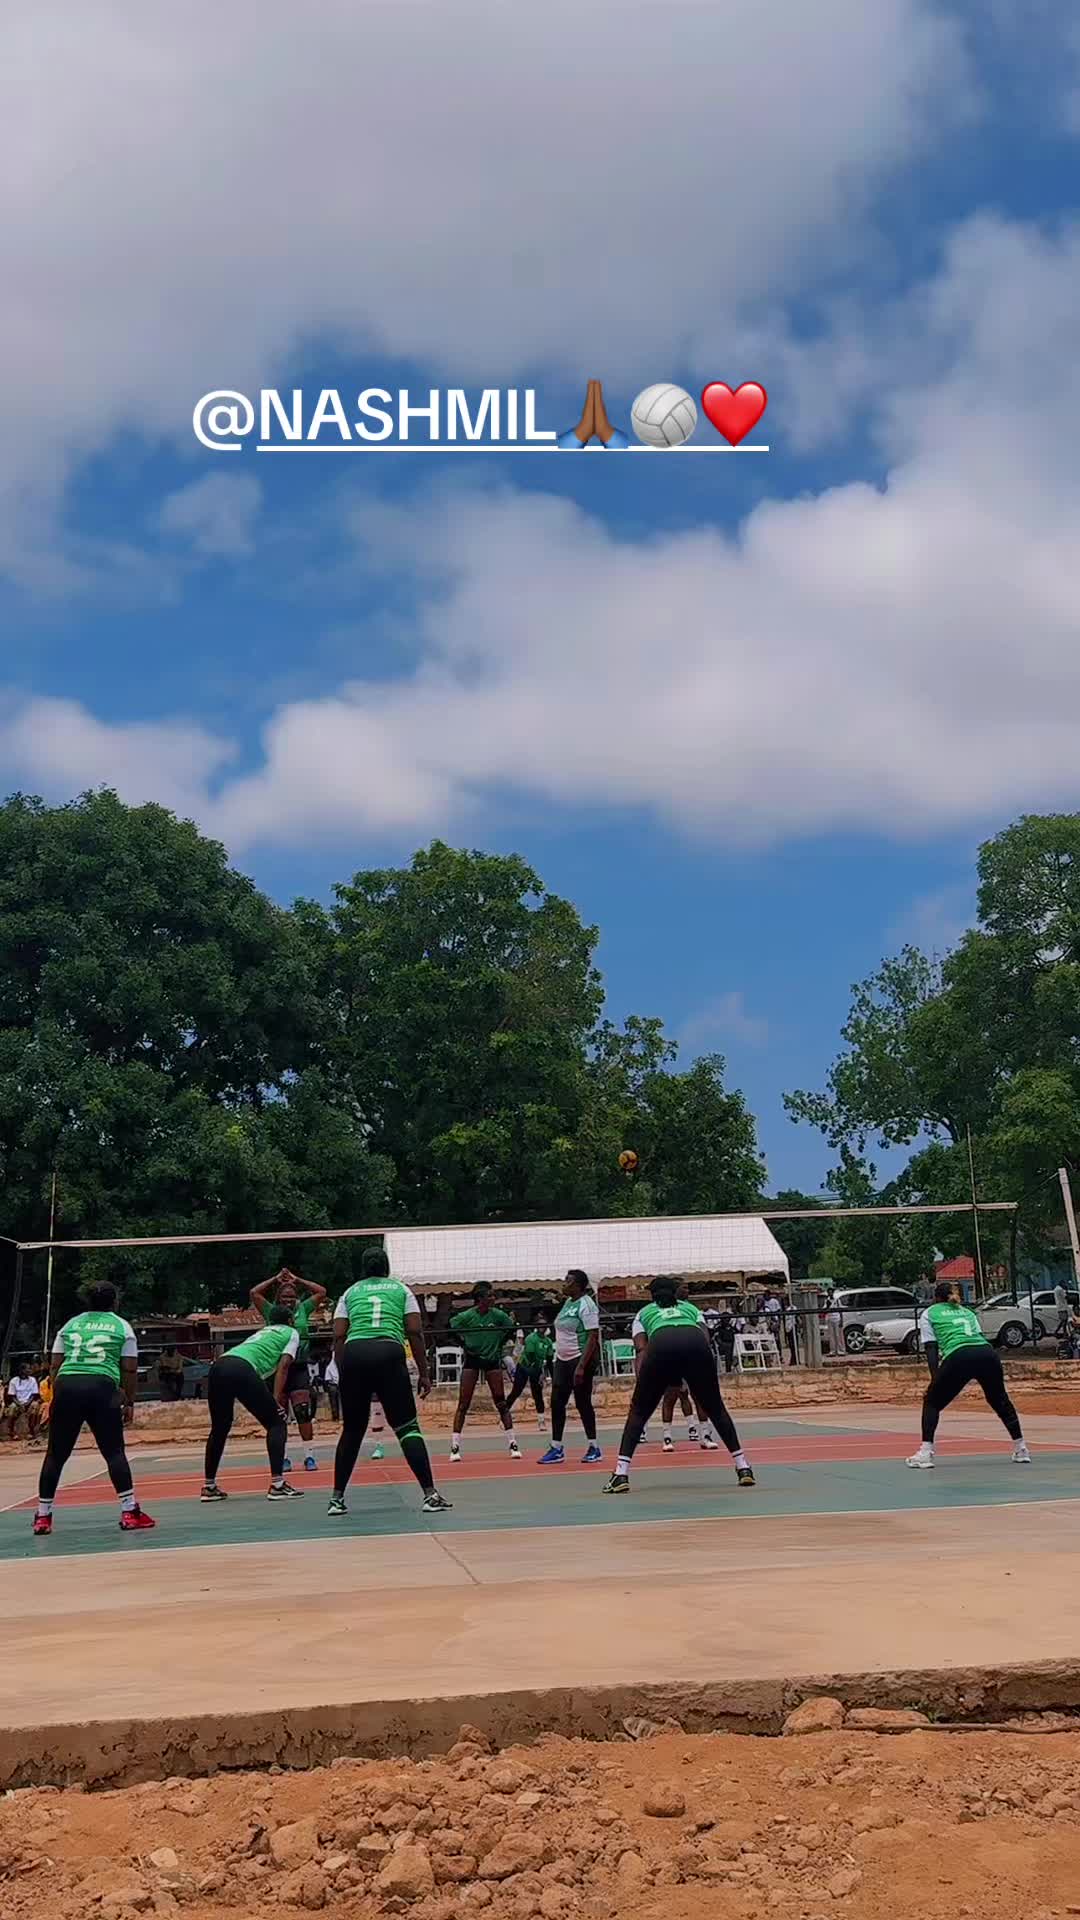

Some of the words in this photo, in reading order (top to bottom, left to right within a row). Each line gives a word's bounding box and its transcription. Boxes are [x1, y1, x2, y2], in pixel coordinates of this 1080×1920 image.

[367, 1295, 383, 1328] 1
[951, 1317, 973, 1337] 7
[68, 1332, 112, 1363] 15
